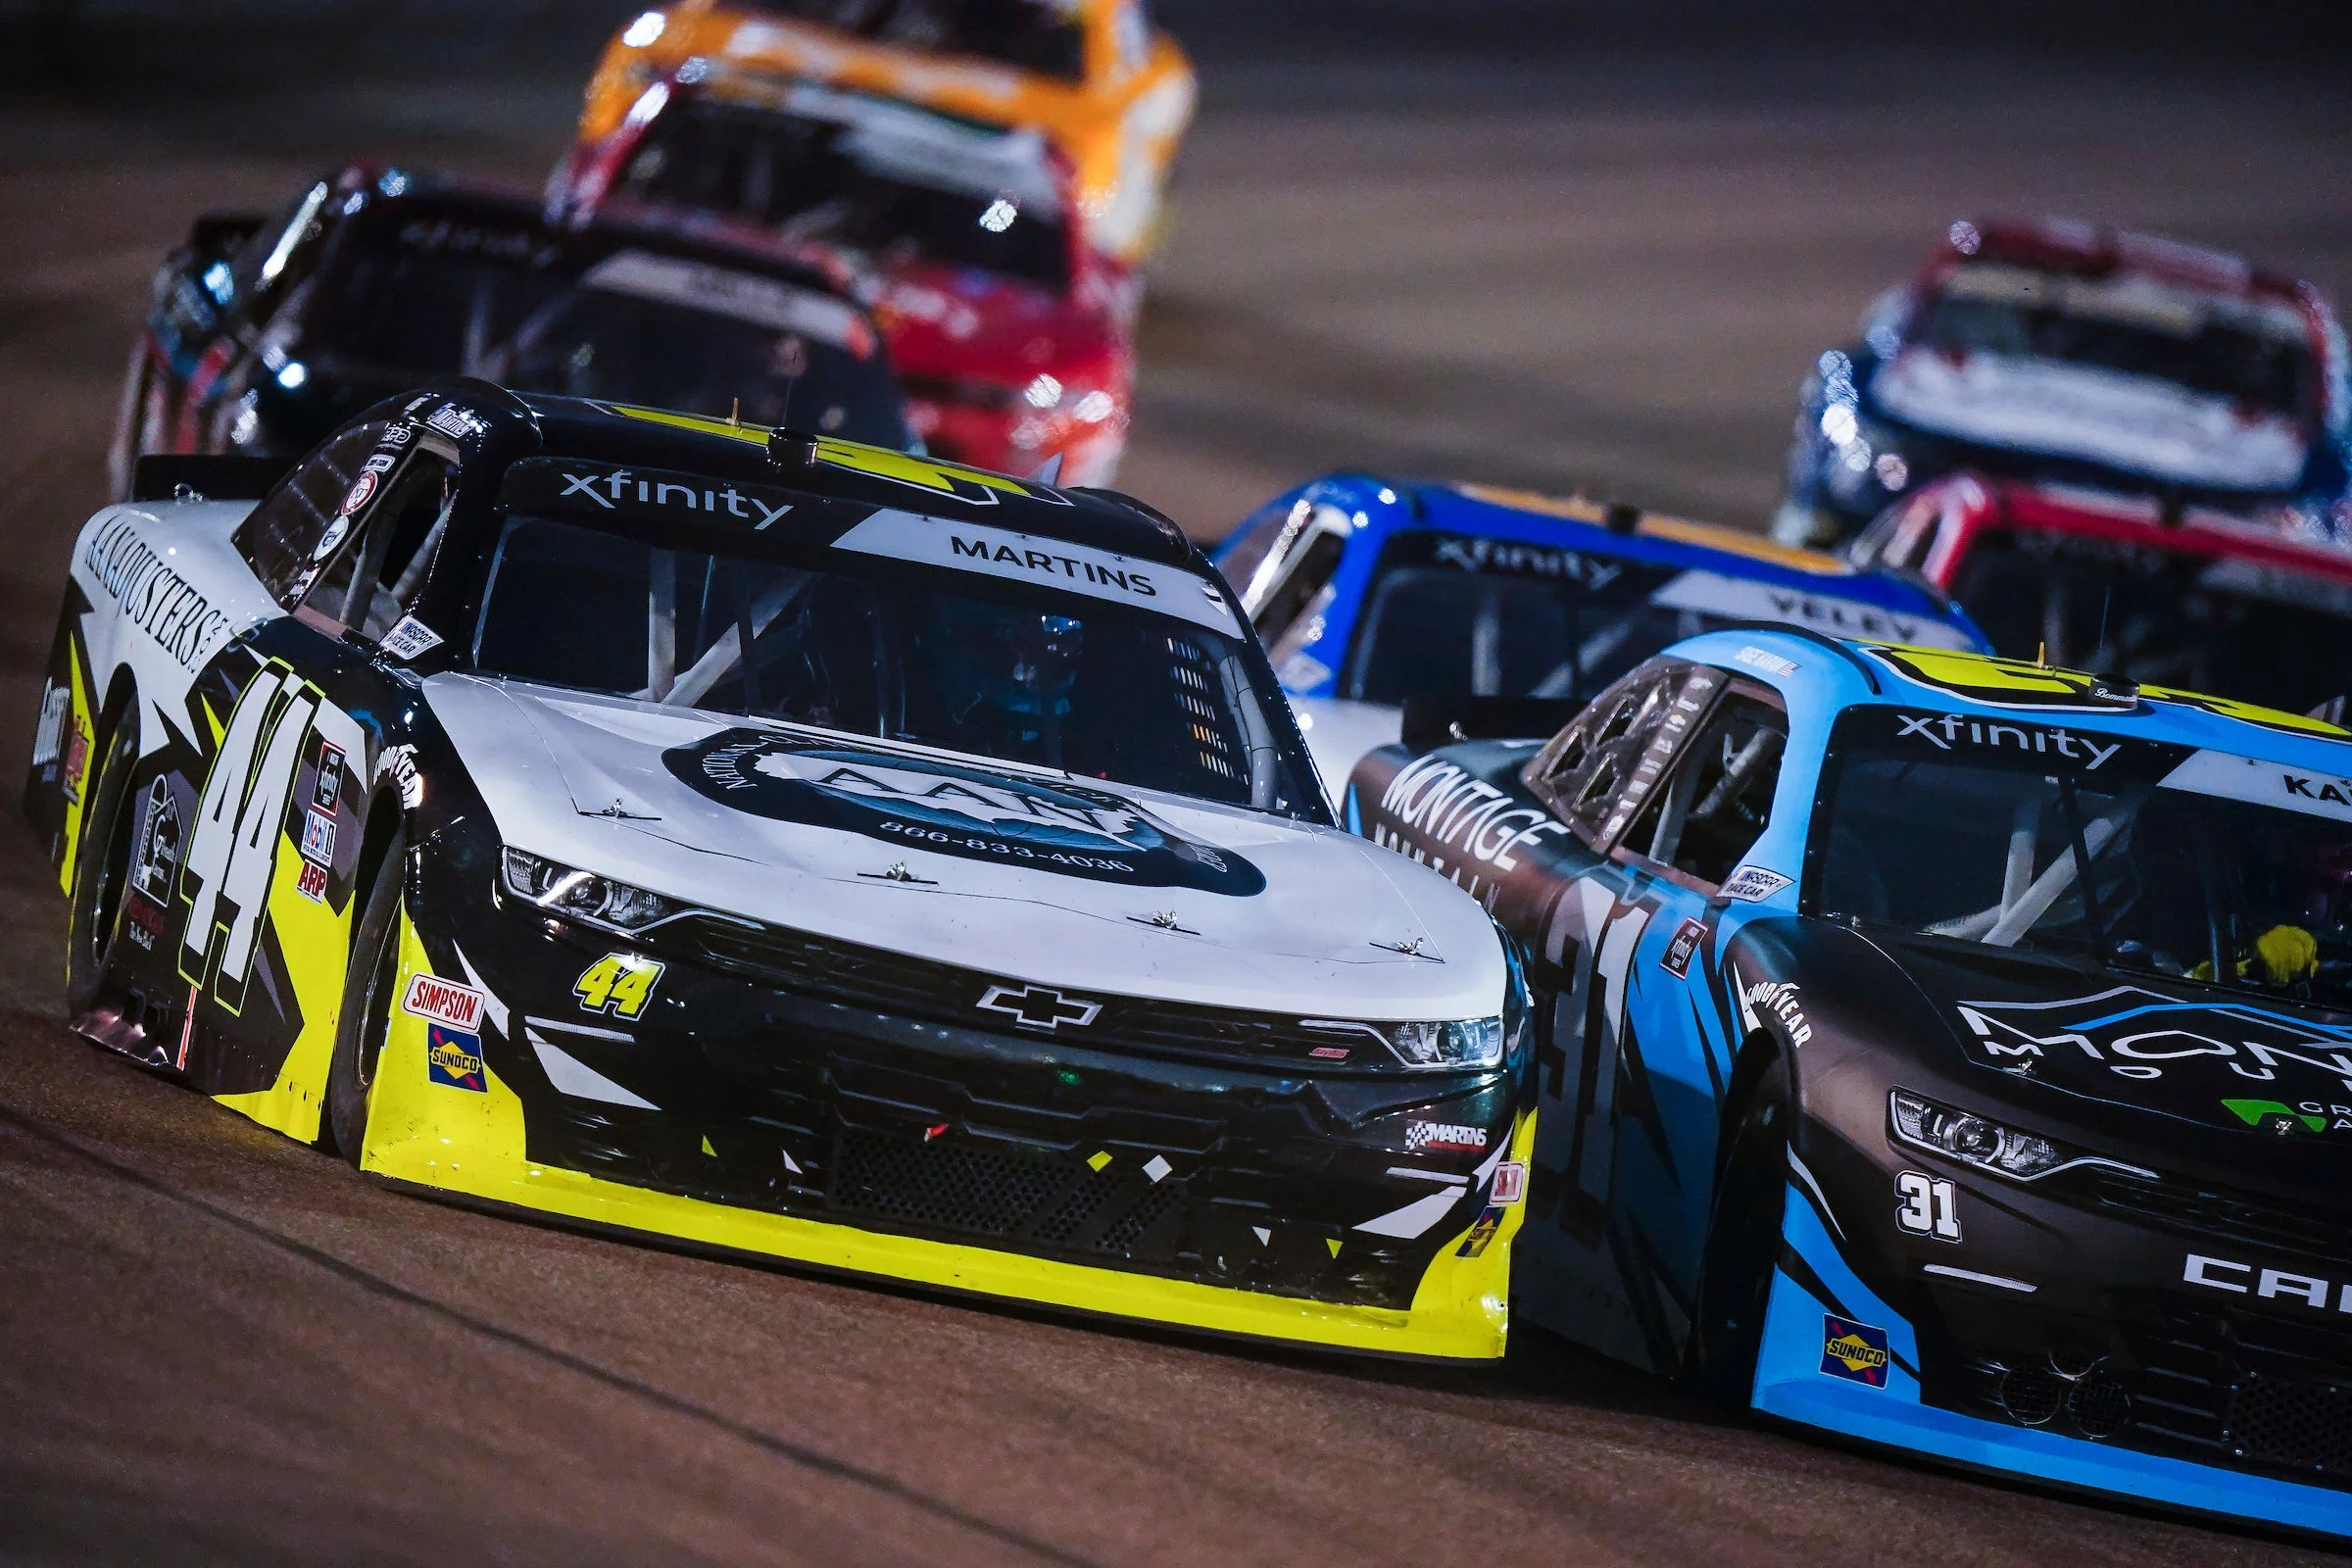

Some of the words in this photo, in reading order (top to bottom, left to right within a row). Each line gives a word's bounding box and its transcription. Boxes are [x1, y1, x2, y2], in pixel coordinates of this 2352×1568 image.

[560, 468, 794, 531] xfinity
[951, 536, 1156, 596] MARTINS
[1897, 713, 2122, 770] xfinity
[1381, 754, 1572, 872] MONTAGE
[2283, 774, 2352, 807] KA
[181, 662, 323, 1009] 44
[880, 821, 1135, 873] 866-833-4036
[298, 861, 326, 898] ARP
[412, 981, 478, 1023] SIMPSON
[574, 954, 664, 1019] 44
[1744, 982, 1812, 1049] GOODYEAR
[432, 1049, 478, 1072] SUNOCO
[1984, 1041, 2352, 1092] MOU
[1896, 1171, 1961, 1242] 31
[1829, 1340, 1886, 1365] SUNOCO
